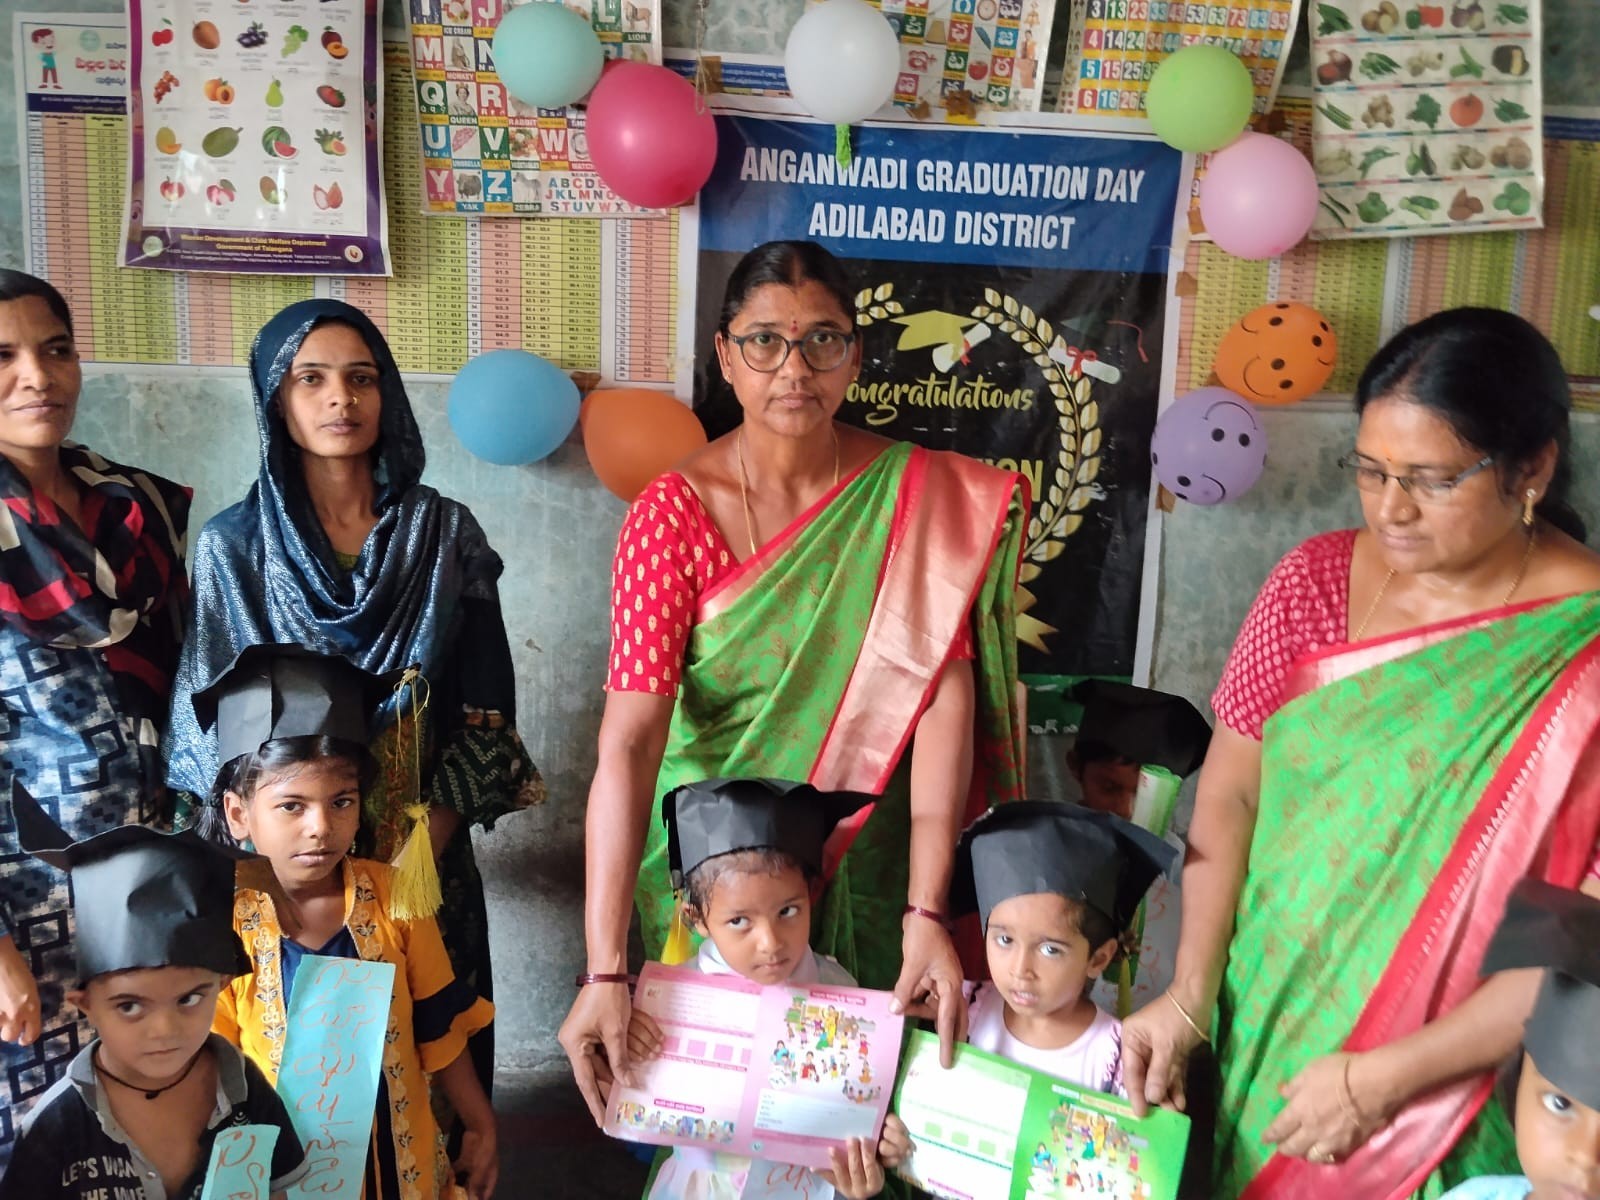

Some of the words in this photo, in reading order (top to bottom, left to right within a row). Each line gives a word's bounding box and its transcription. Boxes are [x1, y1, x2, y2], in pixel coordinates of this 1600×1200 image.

[1091, 0, 1101, 18] 3
[1110, 1, 1127, 19] 13
[1130, 2, 1148, 19] 23
[1151, 2, 1168, 20] 33
[1187, 5, 1204, 23] 53
[1207, 7, 1225, 25] 63
[1229, 9, 1247, 27] 73
[1250, 10, 1267, 28] 83
[1270, 11, 1288, 30] 93
[627, 33, 648, 41] LION
[1088, 30, 1098, 48] 4
[1106, 31, 1124, 49] 14
[1127, 31, 1145, 49] 24
[1147, 32, 1163, 50] 34
[415, 37, 441, 62] M
[478, 40, 495, 64] N
[446, 72, 474, 80] MONKEY
[1086, 61, 1095, 78] 5
[1104, 61, 1120, 79] 15
[1123, 61, 1140, 79] 25
[421, 81, 444, 106] Q
[480, 84, 502, 108] R
[1083, 90, 1093, 107] 6
[1101, 91, 1118, 109] 16
[1121, 91, 1138, 109] 26
[450, 116, 478, 124] QUEEN
[509, 118, 537, 126] RABBIT
[425, 125, 447, 149] U
[483, 127, 504, 151] V
[540, 130, 566, 153] W
[428, 169, 449, 193] Y
[486, 171, 508, 194] Z
[740, 147, 908, 190] ANGANWADI
[916, 161, 1089, 200] GRADUATION
[1094, 167, 1145, 203] DAY
[514, 203, 541, 211] ZEBRA
[808, 203, 946, 244] ADILABAD
[954, 210, 1077, 250] DISTRICT
[216, 243, 254, 251] Government
[292, 239, 327, 247] Department
[845, 373, 1034, 426] ongratulations
